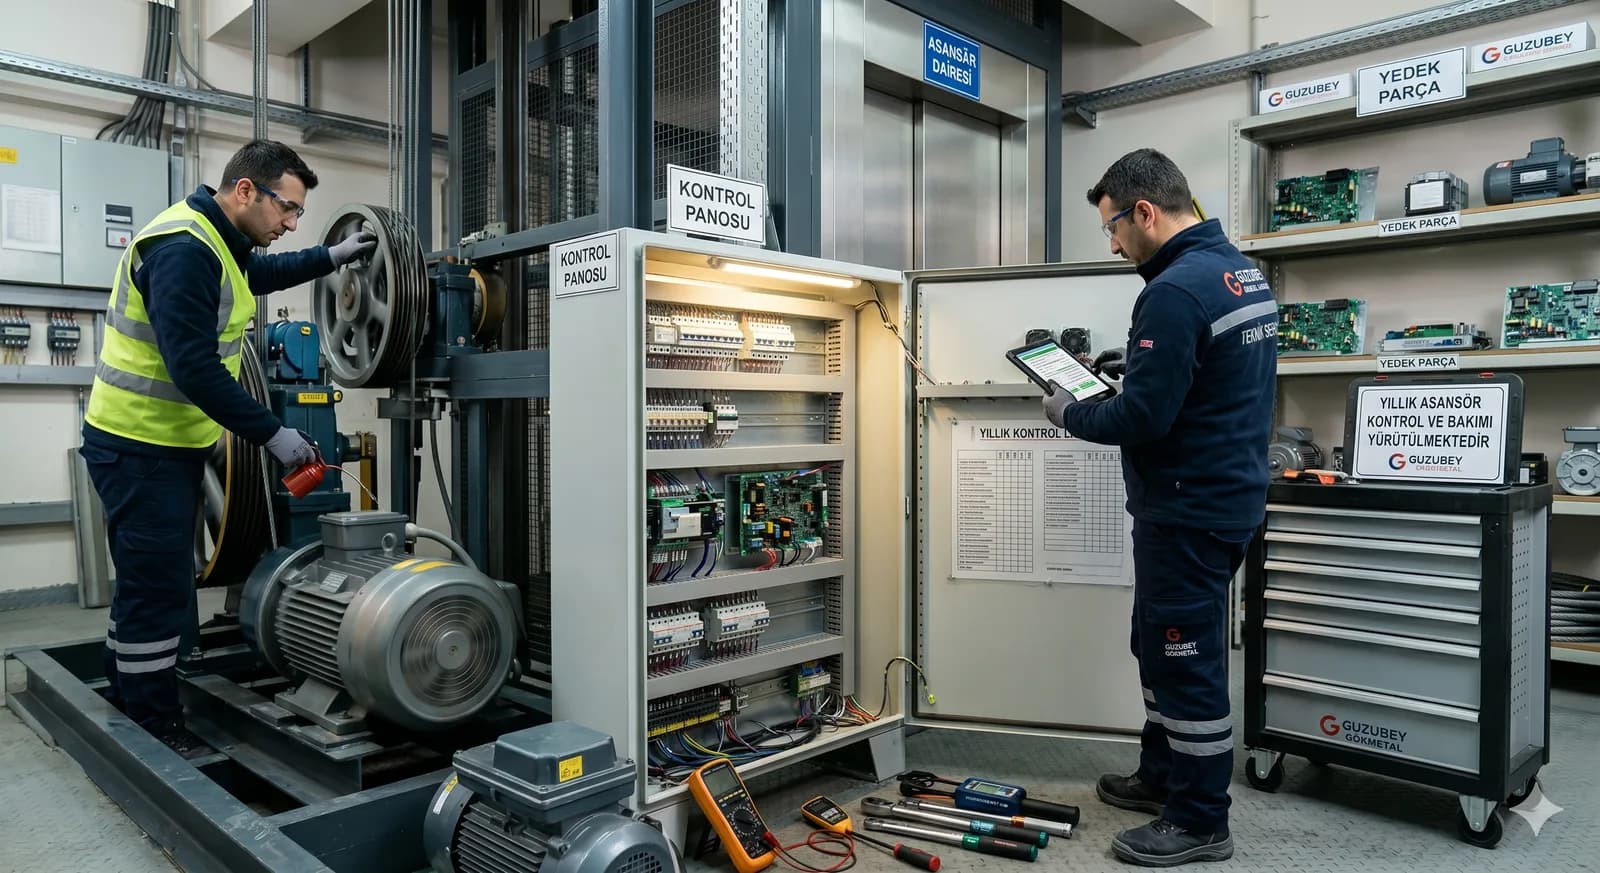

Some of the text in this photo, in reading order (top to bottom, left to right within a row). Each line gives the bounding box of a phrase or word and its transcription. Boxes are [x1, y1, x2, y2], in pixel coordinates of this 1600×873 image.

[928, 36, 977, 69] ASANSÄR
[1503, 31, 1574, 55] GUZUBEY
[932, 58, 972, 87] DAİRESİ
[1379, 60, 1441, 84] YEDEK
[1285, 80, 1340, 100] GUZUBEY
[1379, 80, 1441, 104] PARÇA
[679, 179, 756, 210] KONTROL
[685, 204, 751, 231] PANOSU
[1381, 216, 1457, 233] YEDEK PARÇA
[560, 243, 611, 268] KONTROL
[564, 265, 608, 288] PANOSU
[1380, 357, 1456, 368] YEDEK PARÇA
[1380, 393, 1482, 410] YILLIK ASANSÖR
[1367, 415, 1493, 428] KONTROL VE BAKIMI
[979, 428, 1010, 439] YILLIK
[1013, 428, 1062, 439] KONTROL
[1368, 430, 1490, 448] YÜRÜTÜLMEKTEDİR
[1408, 455, 1463, 466] GUZUBEY
[1164, 641, 1197, 651] GUZUBEY
[1342, 720, 1408, 742] GUZUBEY
